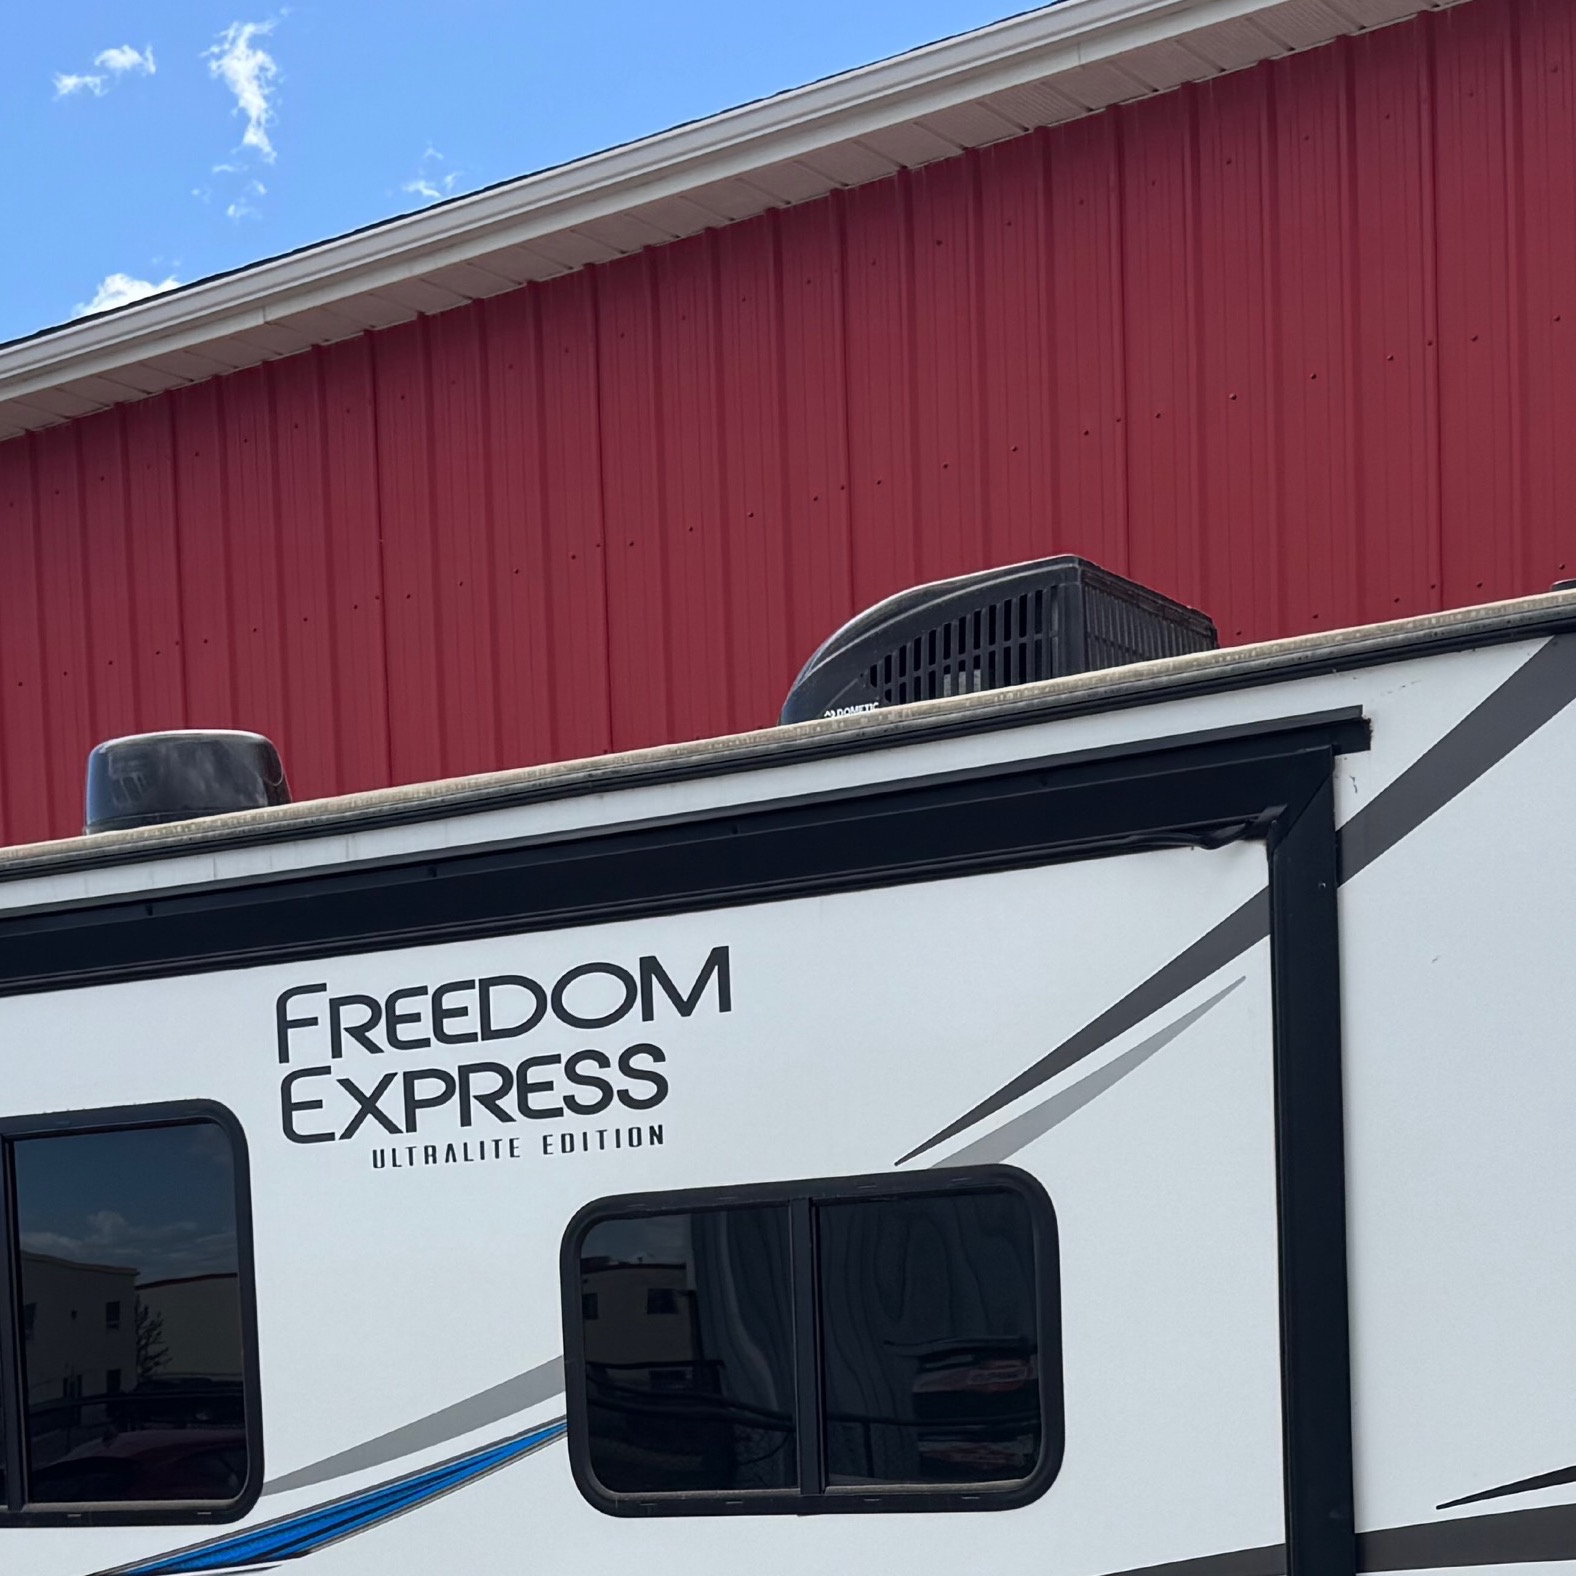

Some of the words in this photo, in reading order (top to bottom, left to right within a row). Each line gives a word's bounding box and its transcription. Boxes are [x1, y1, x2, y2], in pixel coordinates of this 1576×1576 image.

[837, 702, 879, 717] DOMETIC
[275, 945, 733, 1064] FREEDOM
[280, 1043, 669, 1145] EXPRESS
[372, 1136, 521, 1169] ULTRALITE
[542, 1124, 665, 1156] EDITION
